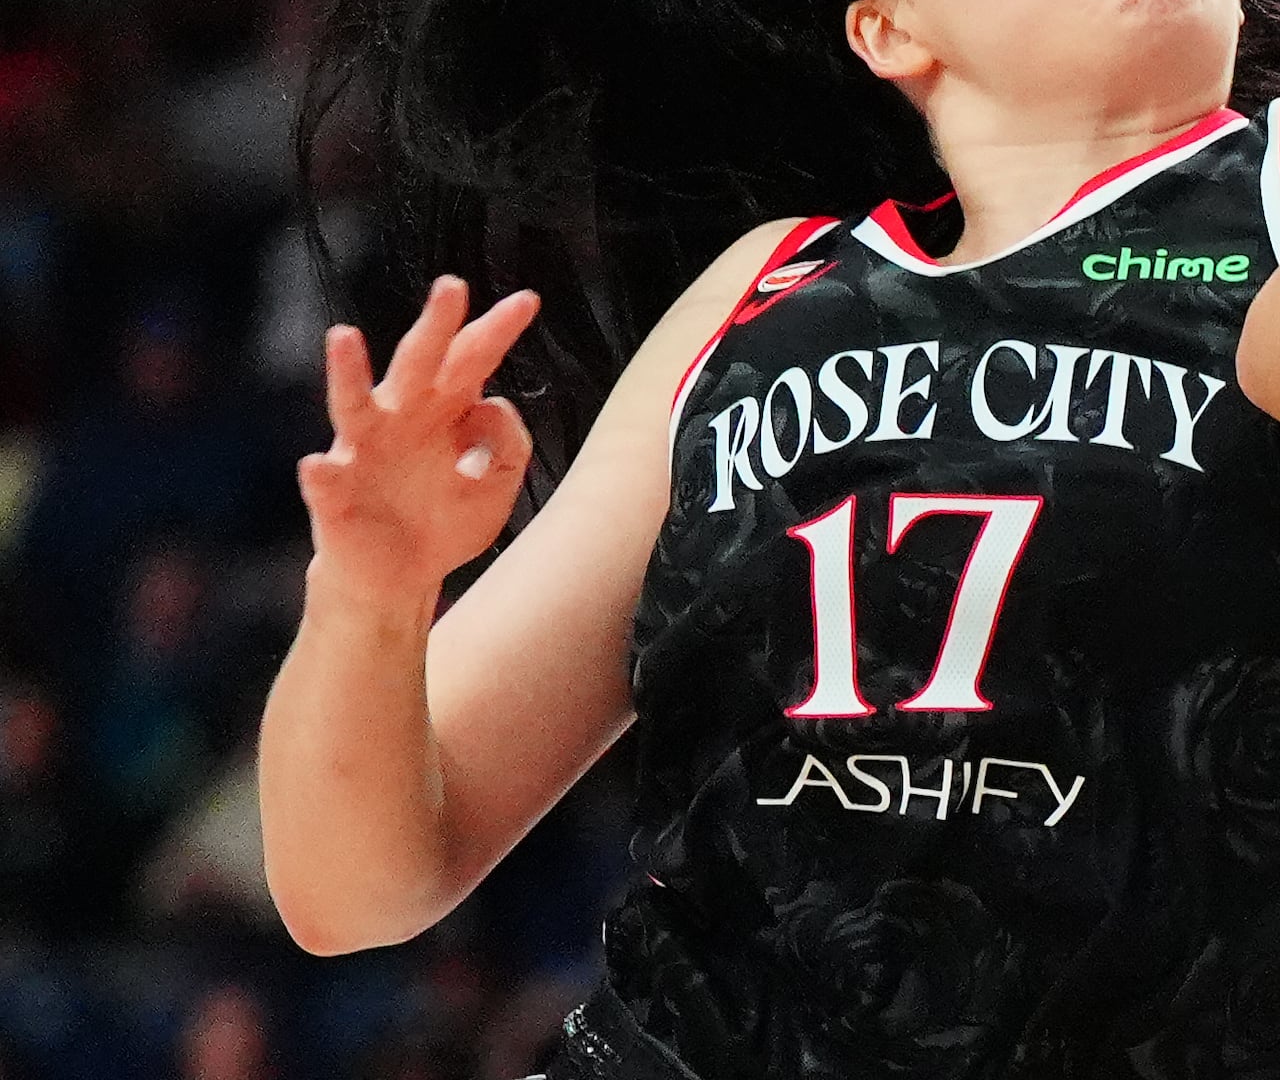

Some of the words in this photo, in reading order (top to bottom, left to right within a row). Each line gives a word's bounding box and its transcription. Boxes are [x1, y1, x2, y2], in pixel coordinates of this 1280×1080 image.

[1082, 247, 1250, 283] chime
[706, 339, 941, 513] ROSE
[970, 339, 1226, 472] CITY
[784, 492, 1045, 720] 17
